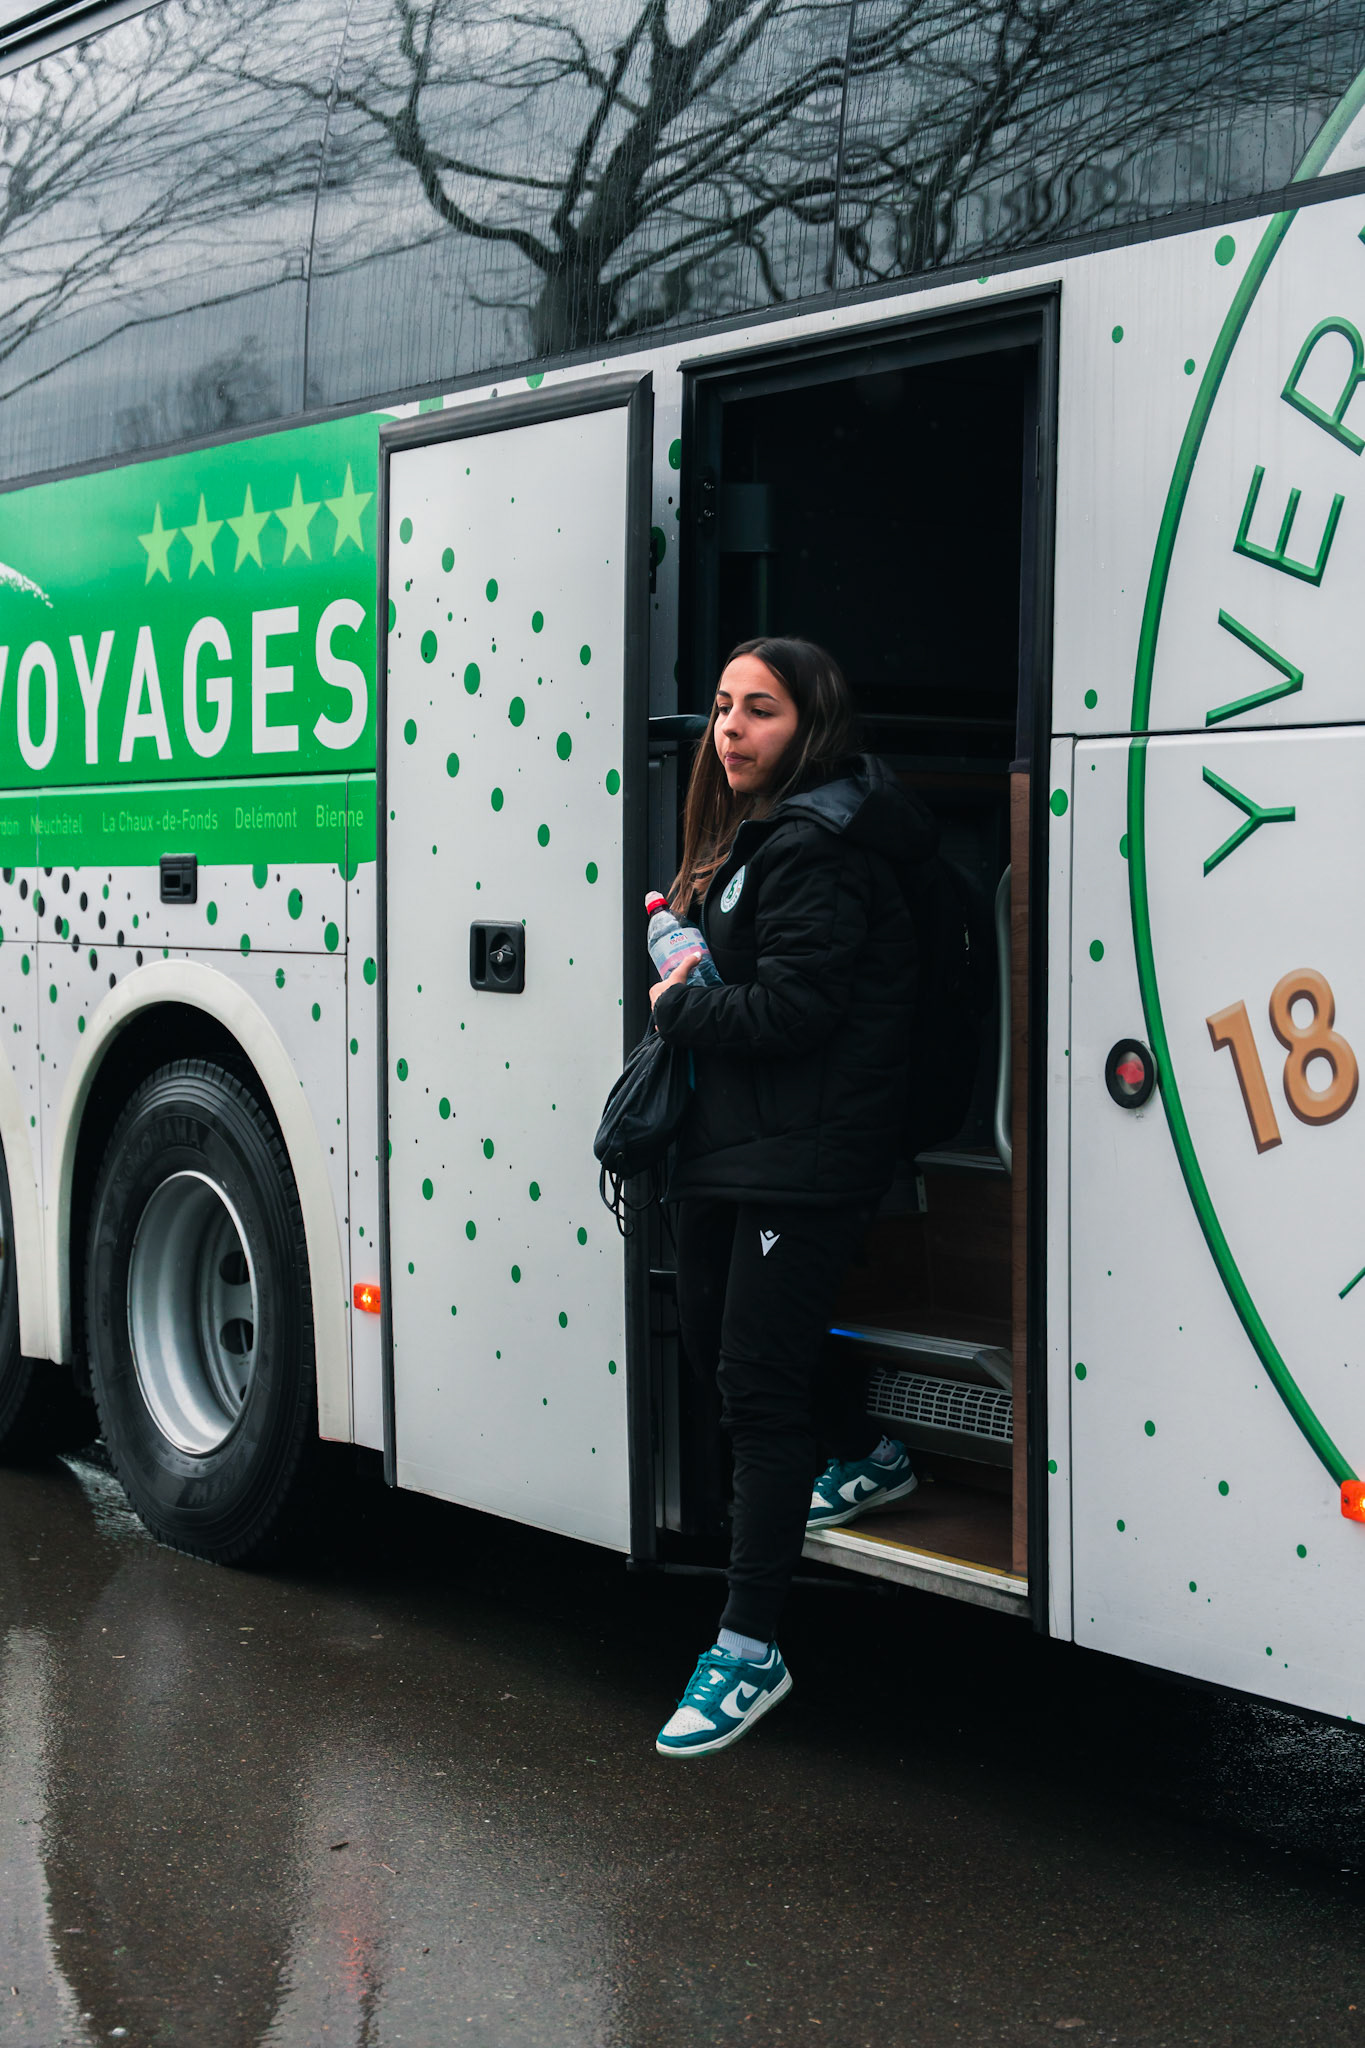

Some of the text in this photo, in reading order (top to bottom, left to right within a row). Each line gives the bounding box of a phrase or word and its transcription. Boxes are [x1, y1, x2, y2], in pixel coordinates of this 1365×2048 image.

[1203, 224, 1365, 878] YVER
[0, 598, 368, 770] OYAGES
[30, 812, 83, 835] Neuchâtel
[102, 811, 116, 832] La
[235, 804, 297, 829] Delémont
[316, 804, 364, 827] Bienne
[1205, 967, 1360, 1155] 18
